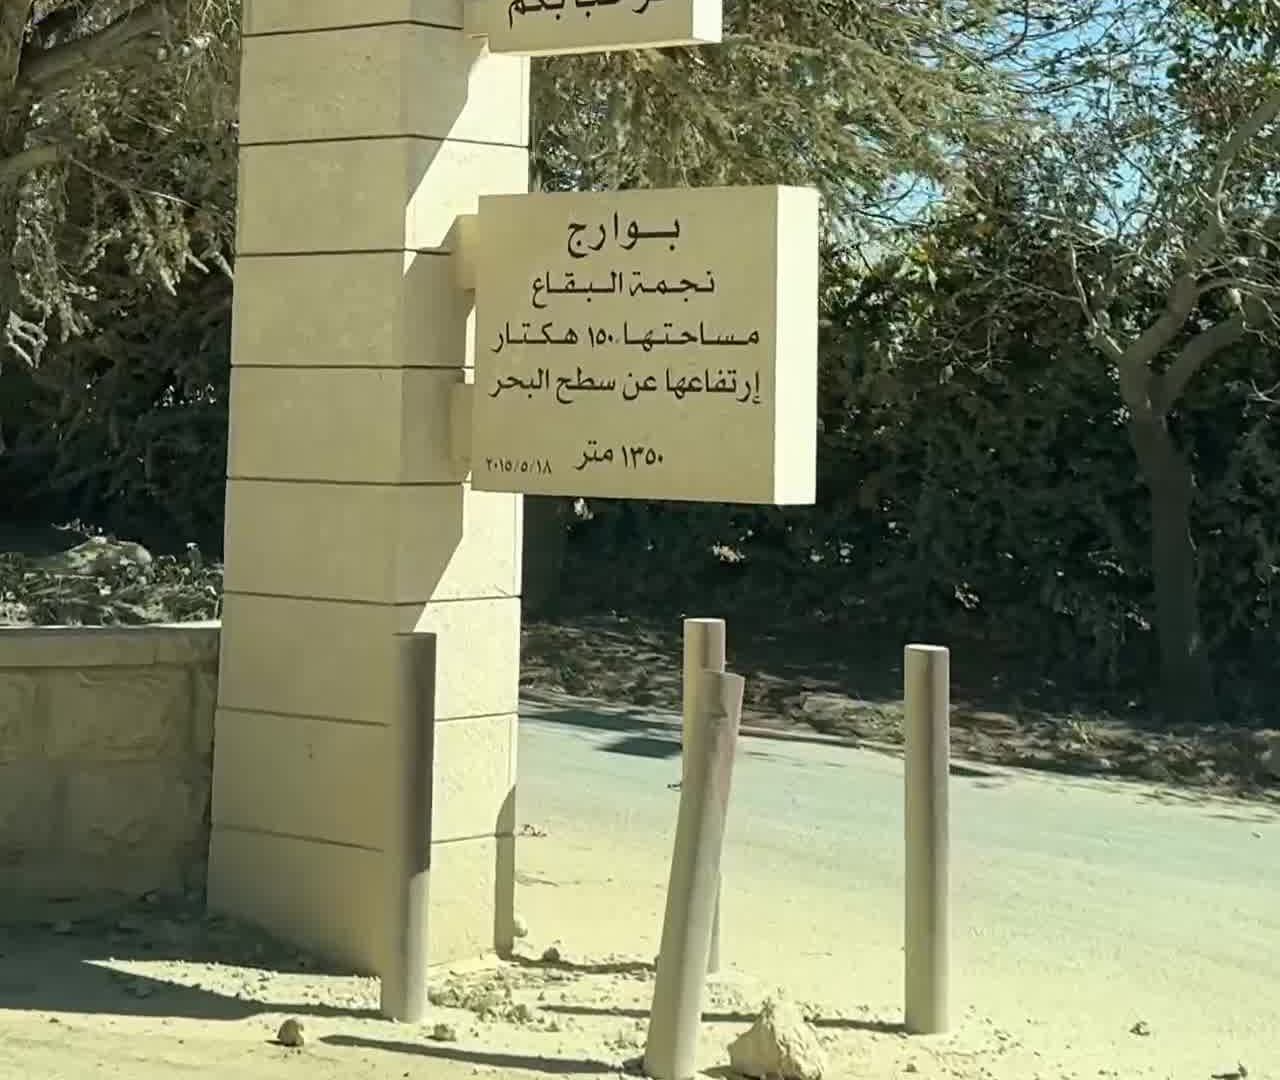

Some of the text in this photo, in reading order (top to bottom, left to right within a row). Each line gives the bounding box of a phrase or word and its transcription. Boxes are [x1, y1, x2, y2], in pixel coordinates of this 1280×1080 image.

[567, 211, 681, 260] بوارج
[531, 270, 715, 310] نجمة البقاع
[491, 321, 760, 354] مساحتها ١٥٠ هكتار
[487, 366, 761, 405] إرتفاعها عن سطح البحر
[575, 439, 664, 471] ١٣٥٠ متر
